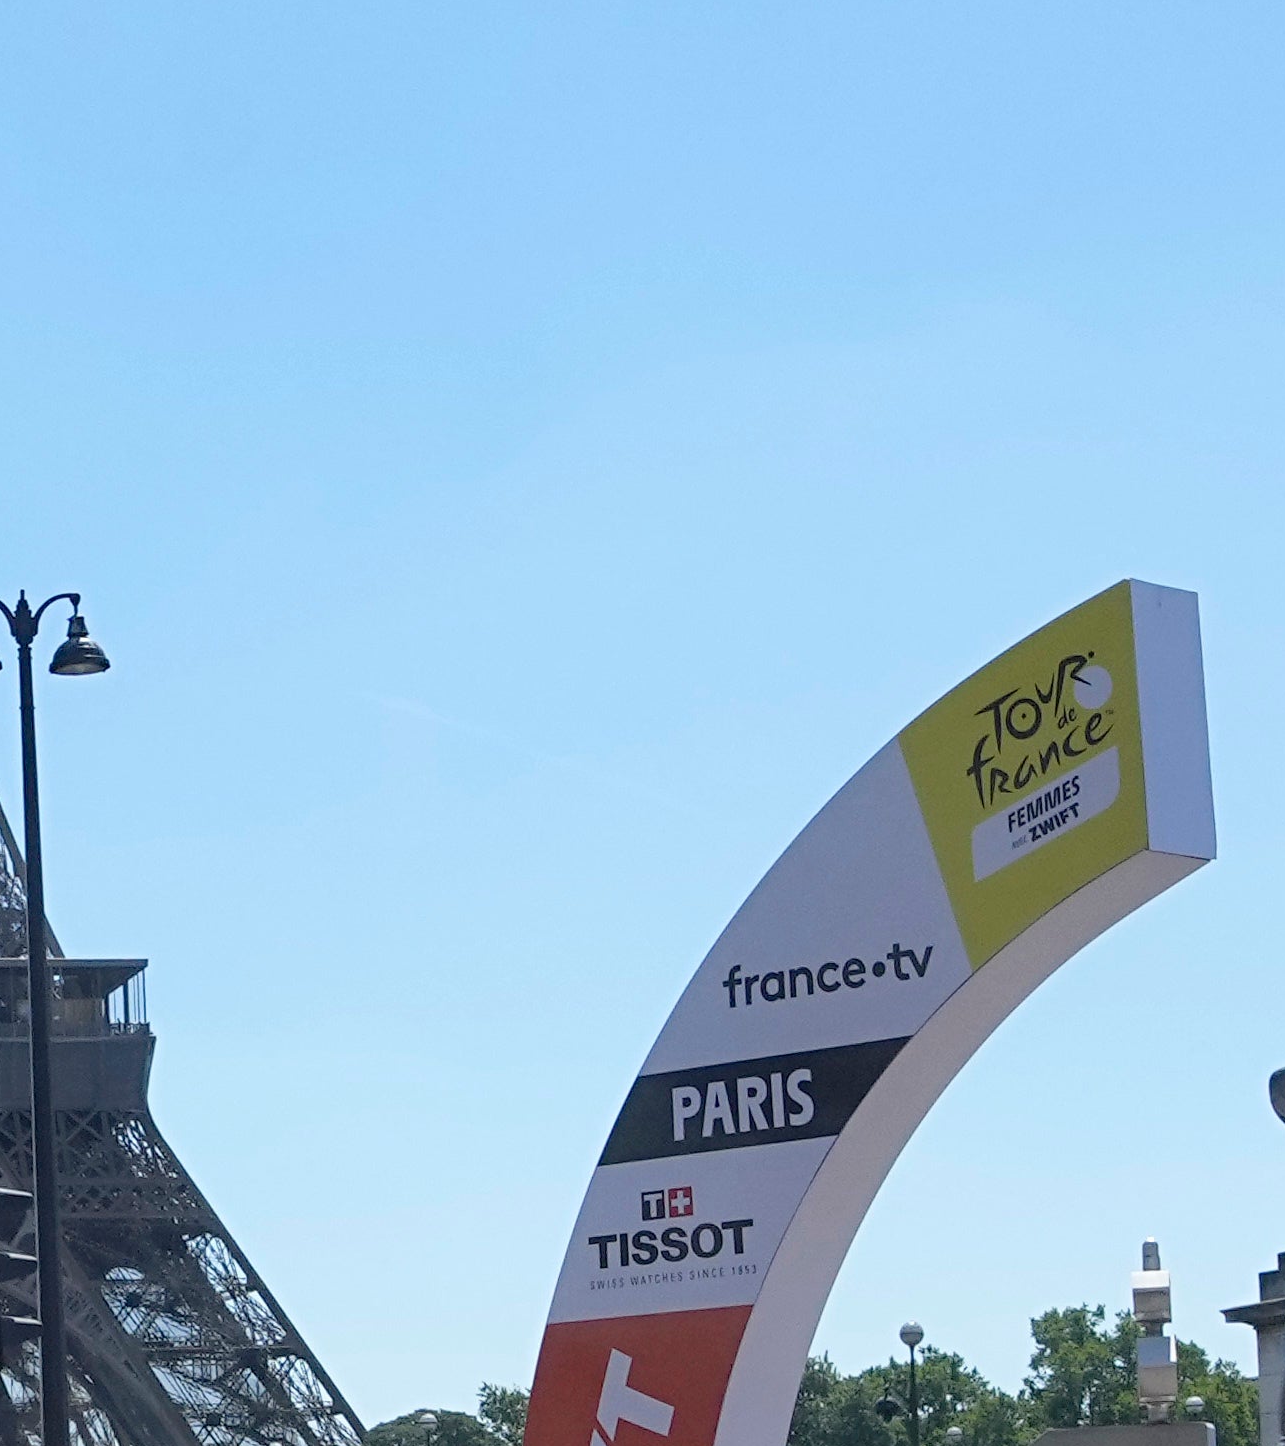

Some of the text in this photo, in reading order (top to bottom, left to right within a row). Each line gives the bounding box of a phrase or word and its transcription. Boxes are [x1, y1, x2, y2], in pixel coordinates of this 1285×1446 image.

[974, 651, 1094, 754] TOUR
[1058, 707, 1078, 729] de
[1008, 775, 1081, 833] FEMMES
[1029, 802, 1080, 843] ZWIFT
[671, 1068, 815, 1142] PARIS
[588, 1218, 754, 1269] TISSOT
[630, 1270, 684, 1287] WATCHES
[689, 1266, 725, 1281] SINCE
